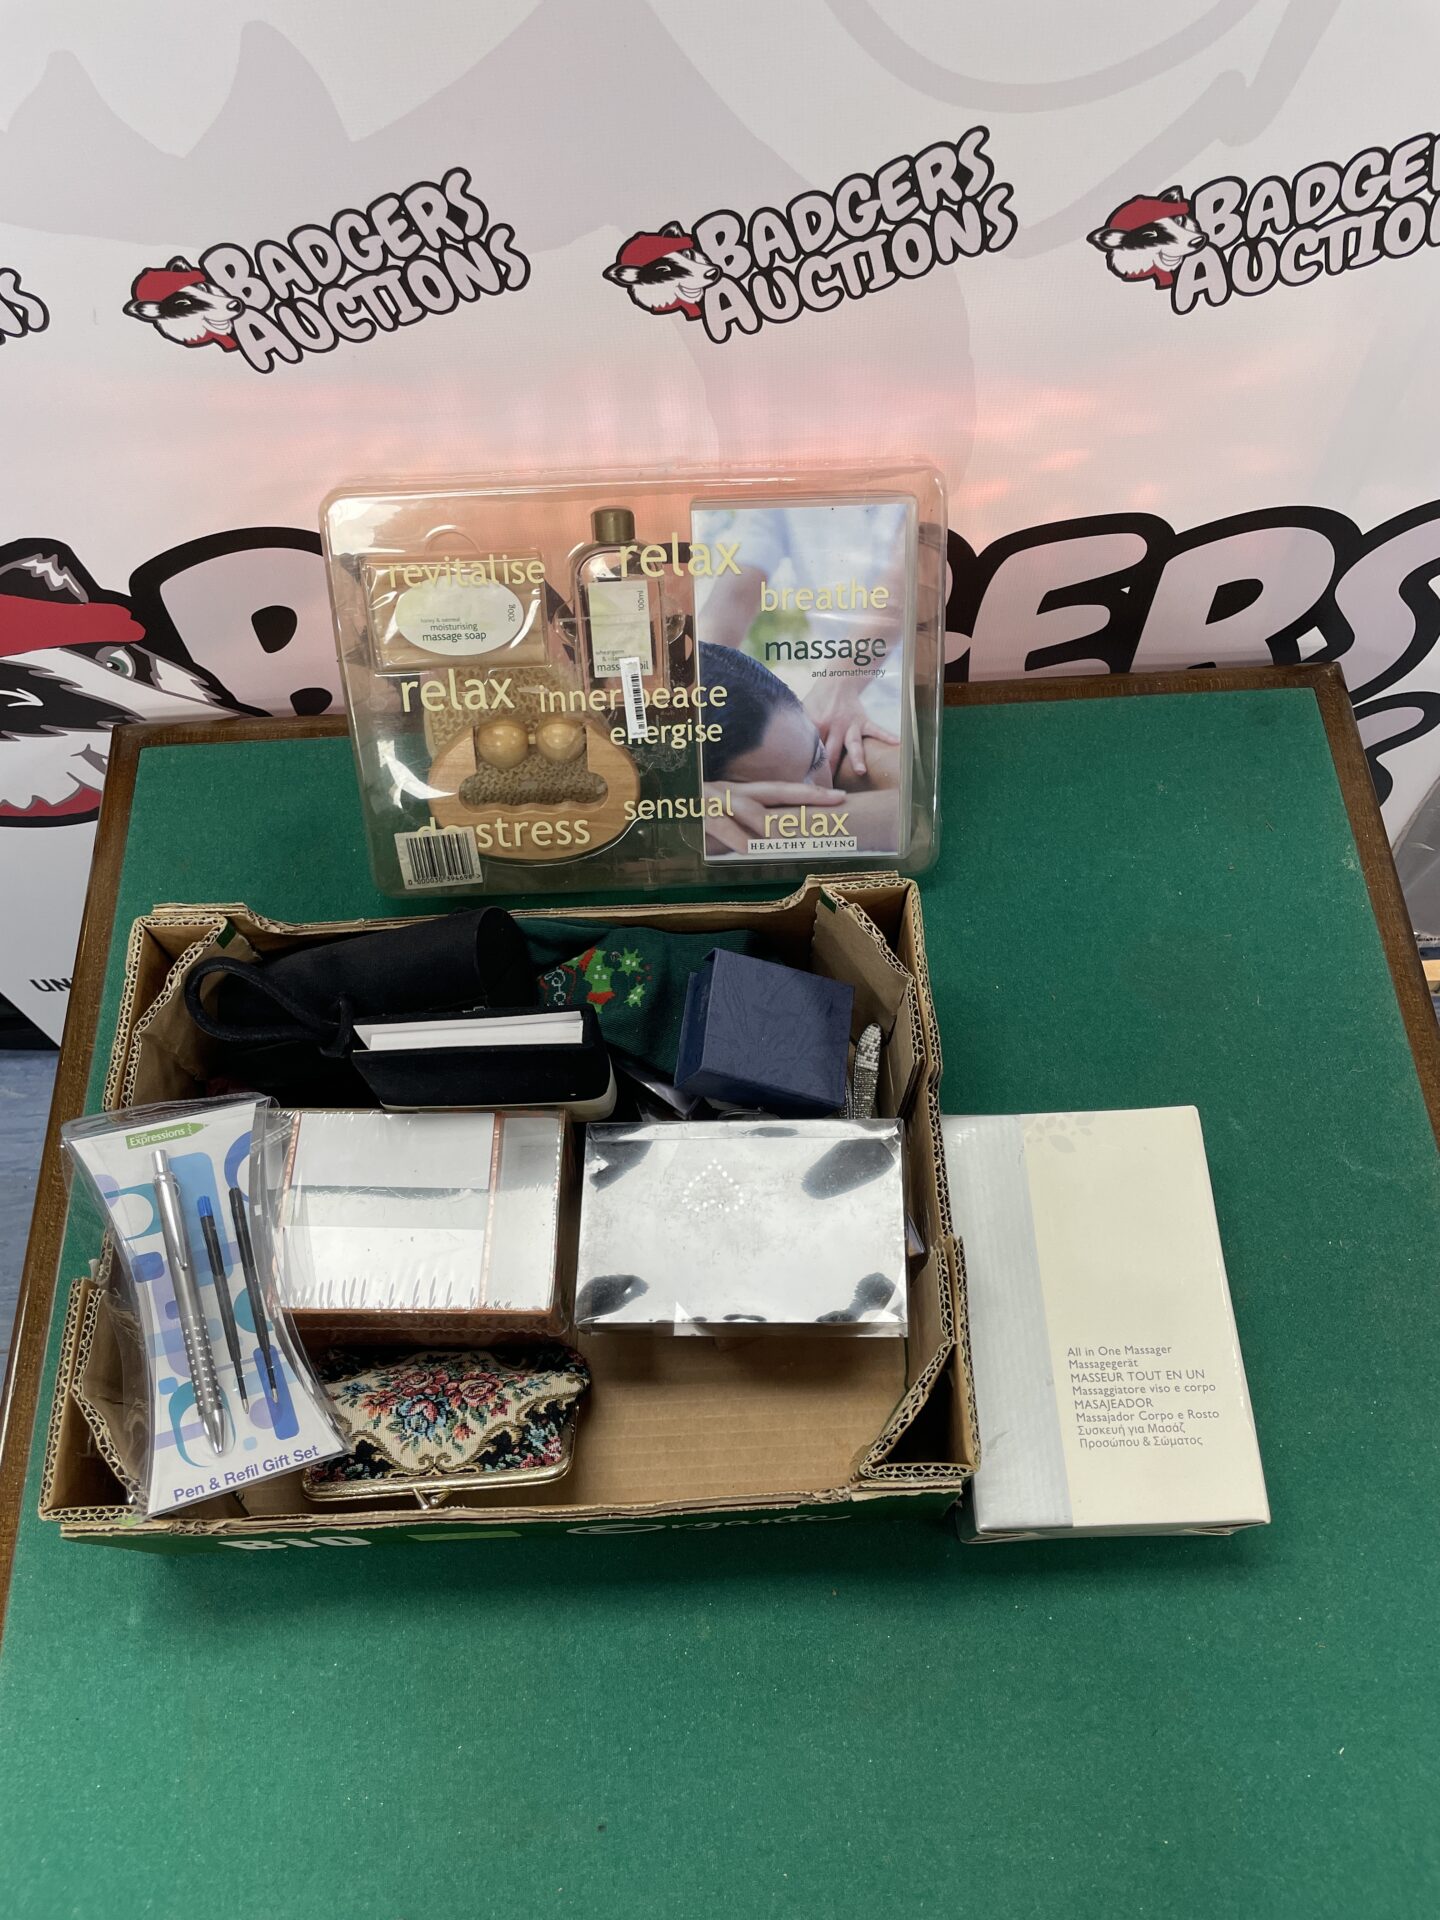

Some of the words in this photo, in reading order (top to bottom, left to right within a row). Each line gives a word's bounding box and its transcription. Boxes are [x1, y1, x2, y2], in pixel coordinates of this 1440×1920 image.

[692, 125, 994, 280] BADGERS
[1191, 131, 1440, 249] BADGE
[199, 167, 489, 312] BADGERS
[700, 182, 1018, 344] AUCTIONS
[1173, 196, 1440, 316] AUCTIO
[232, 223, 531, 374] AUCTIONS
[619, 532, 742, 578] relax
[388, 554, 546, 588] revitalise
[760, 576, 889, 612] breathe
[422, 632, 462, 643] massage
[464, 631, 487, 642] soap
[430, 622, 478, 632] moisturising
[765, 637, 887, 667] massage
[811, 668, 827, 678] and
[828, 668, 887, 679] aromatherapy
[401, 668, 516, 713] relax
[539, 684, 622, 713] inner
[623, 788, 734, 821] sensual
[764, 805, 850, 838] relax
[750, 841, 807, 851] HEALTHY
[812, 839, 855, 849] LIVING
[129, 1128, 186, 1146] Expressions
[1067, 1347, 1082, 1357] All
[1085, 1348, 1095, 1356] in
[1098, 1346, 1121, 1356] One
[1124, 1345, 1172, 1358] Massager
[1068, 1359, 1139, 1371] Massagegerät
[1070, 1372, 1124, 1383] MASSEUR
[1127, 1371, 1161, 1382] TOUT
[1166, 1370, 1182, 1380] EN
[1185, 1369, 1205, 1379] UN
[1072, 1385, 1146, 1397] Massaggiatore
[1149, 1384, 1170, 1393] viso
[1174, 1385, 1181, 1393] e
[1184, 1383, 1216, 1394] corpo
[1074, 1398, 1154, 1411] MASAJEADOR
[1076, 1412, 1135, 1424] Massajador
[1138, 1411, 1174, 1422] Corpo
[1177, 1412, 1184, 1420] e
[1187, 1409, 1219, 1419] Rosto
[1128, 1425, 1145, 1436] για
[1142, 1437, 1151, 1446] &
[173, 1484, 205, 1502] Pen
[209, 1477, 221, 1490] &
[224, 1463, 260, 1485] Refil
[262, 1454, 291, 1473] Gift
[293, 1445, 320, 1463] Set
